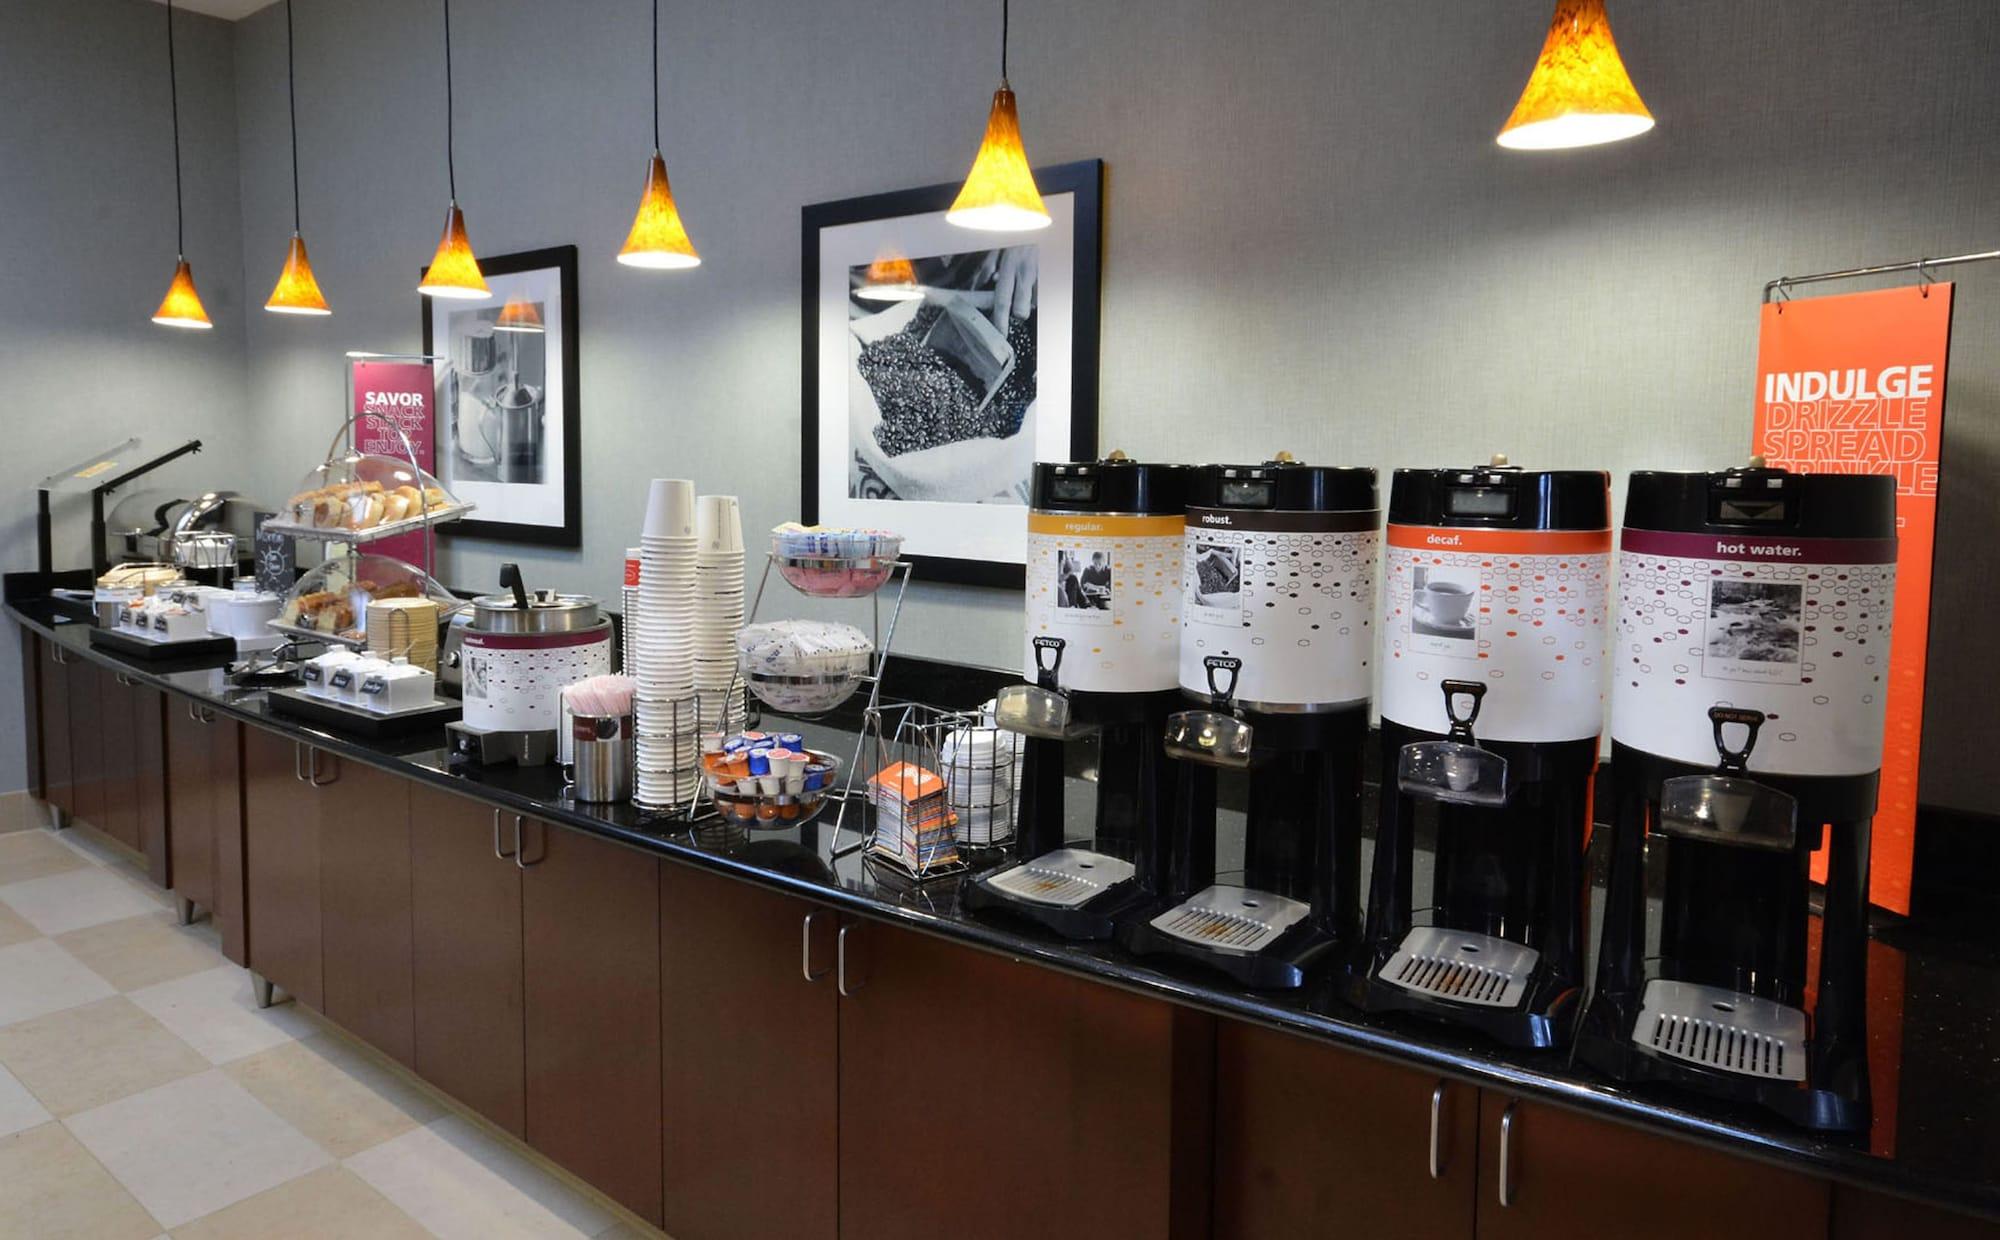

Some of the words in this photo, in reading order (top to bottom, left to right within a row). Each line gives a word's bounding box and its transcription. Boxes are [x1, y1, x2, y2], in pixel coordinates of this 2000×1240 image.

[1764, 364, 1933, 403] INDULGE
[365, 391, 423, 406] SAVOR
[363, 404, 425, 418] SNACK
[1765, 397, 1928, 432] DRIZZLE
[364, 439, 425, 454] ENJOY.
[1763, 429, 1927, 463] SPREAD
[1202, 514, 1232, 525] robust.
[1065, 522, 1104, 533] regular.
[1427, 533, 1463, 546] decaf.
[1716, 541, 1746, 554] hot
[1750, 544, 1802, 557] water.
